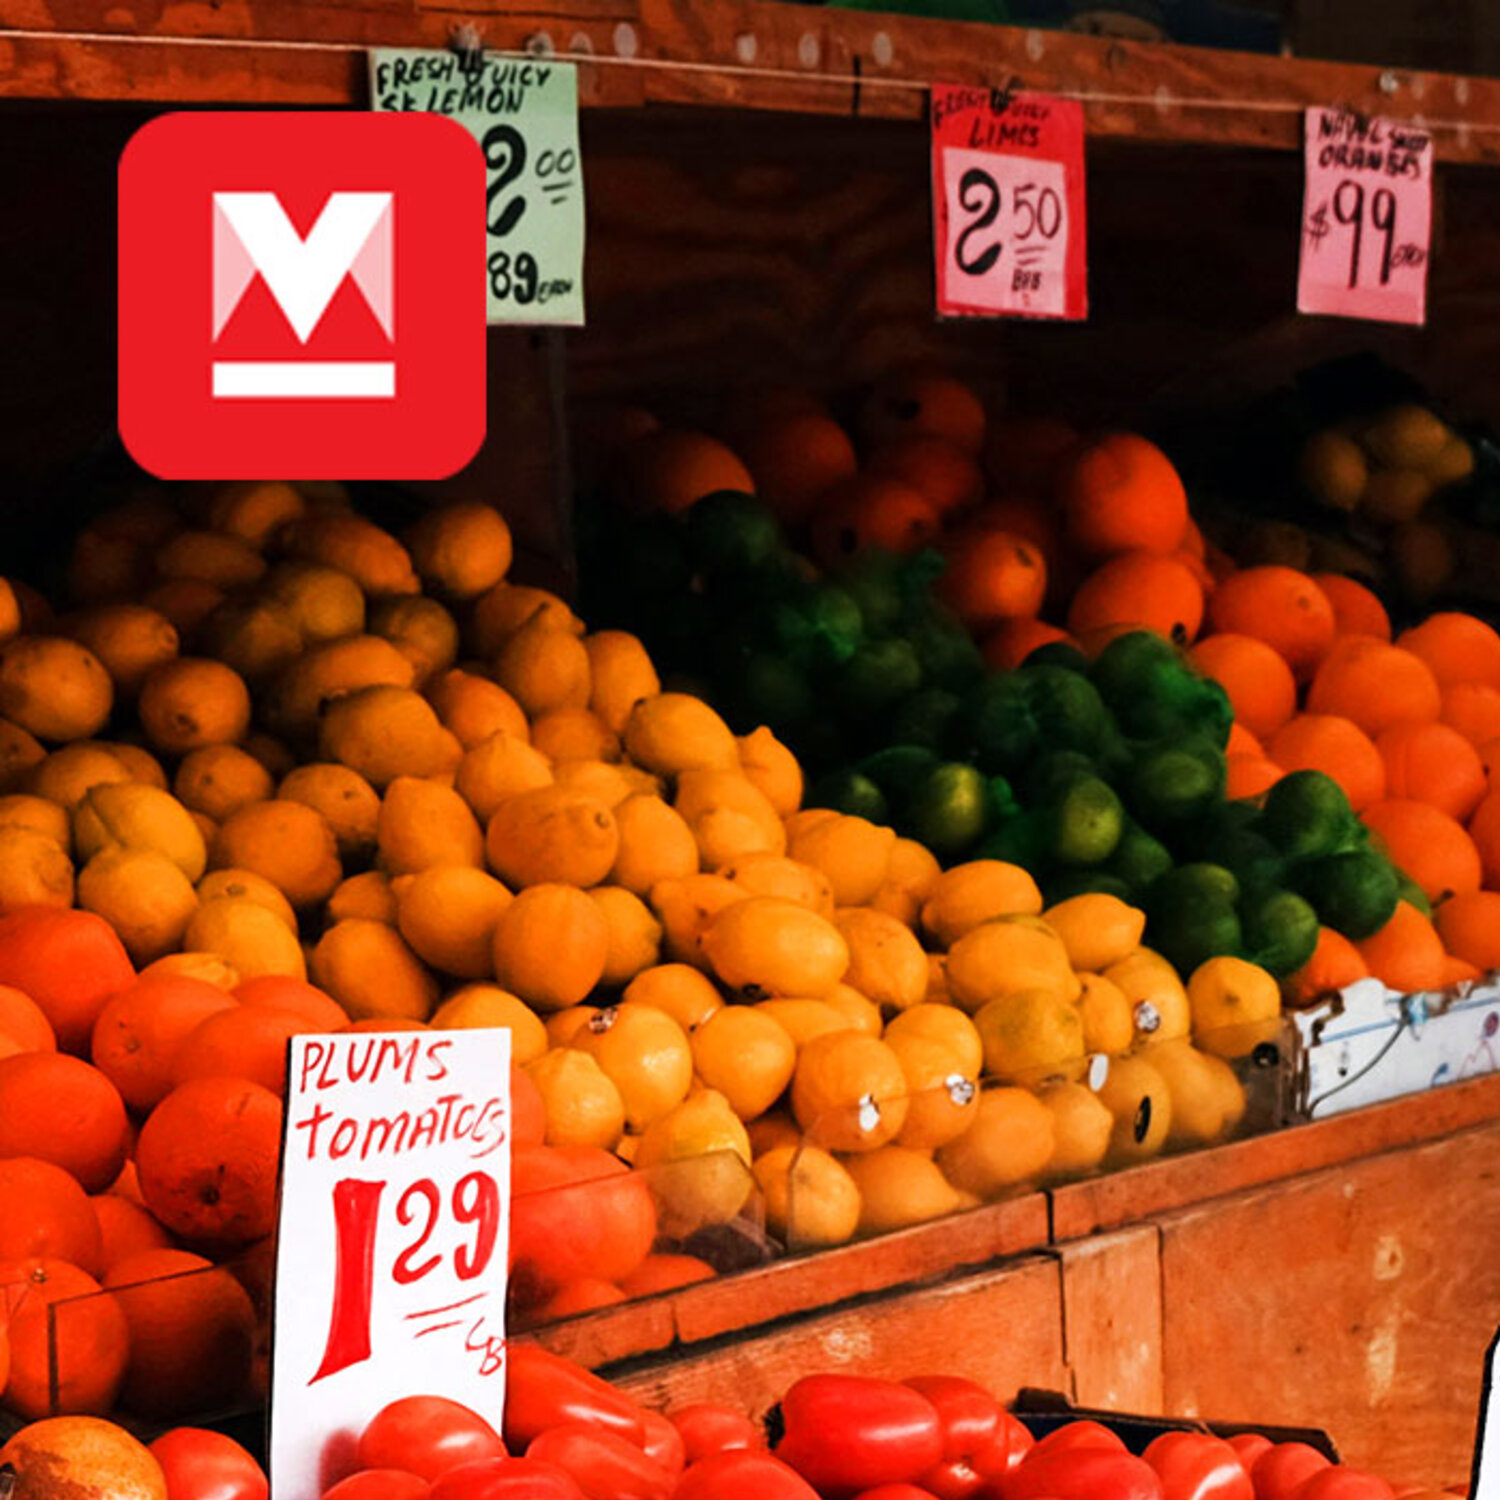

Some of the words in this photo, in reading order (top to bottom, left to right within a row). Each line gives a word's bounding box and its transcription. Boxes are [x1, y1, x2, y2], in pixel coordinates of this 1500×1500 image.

[377, 57, 454, 95] FRESH
[427, 86, 524, 115] LEMON
[955, 167, 1002, 275] 2
[1013, 182, 1061, 239] 50
[299, 1037, 454, 1094] PLUMS
